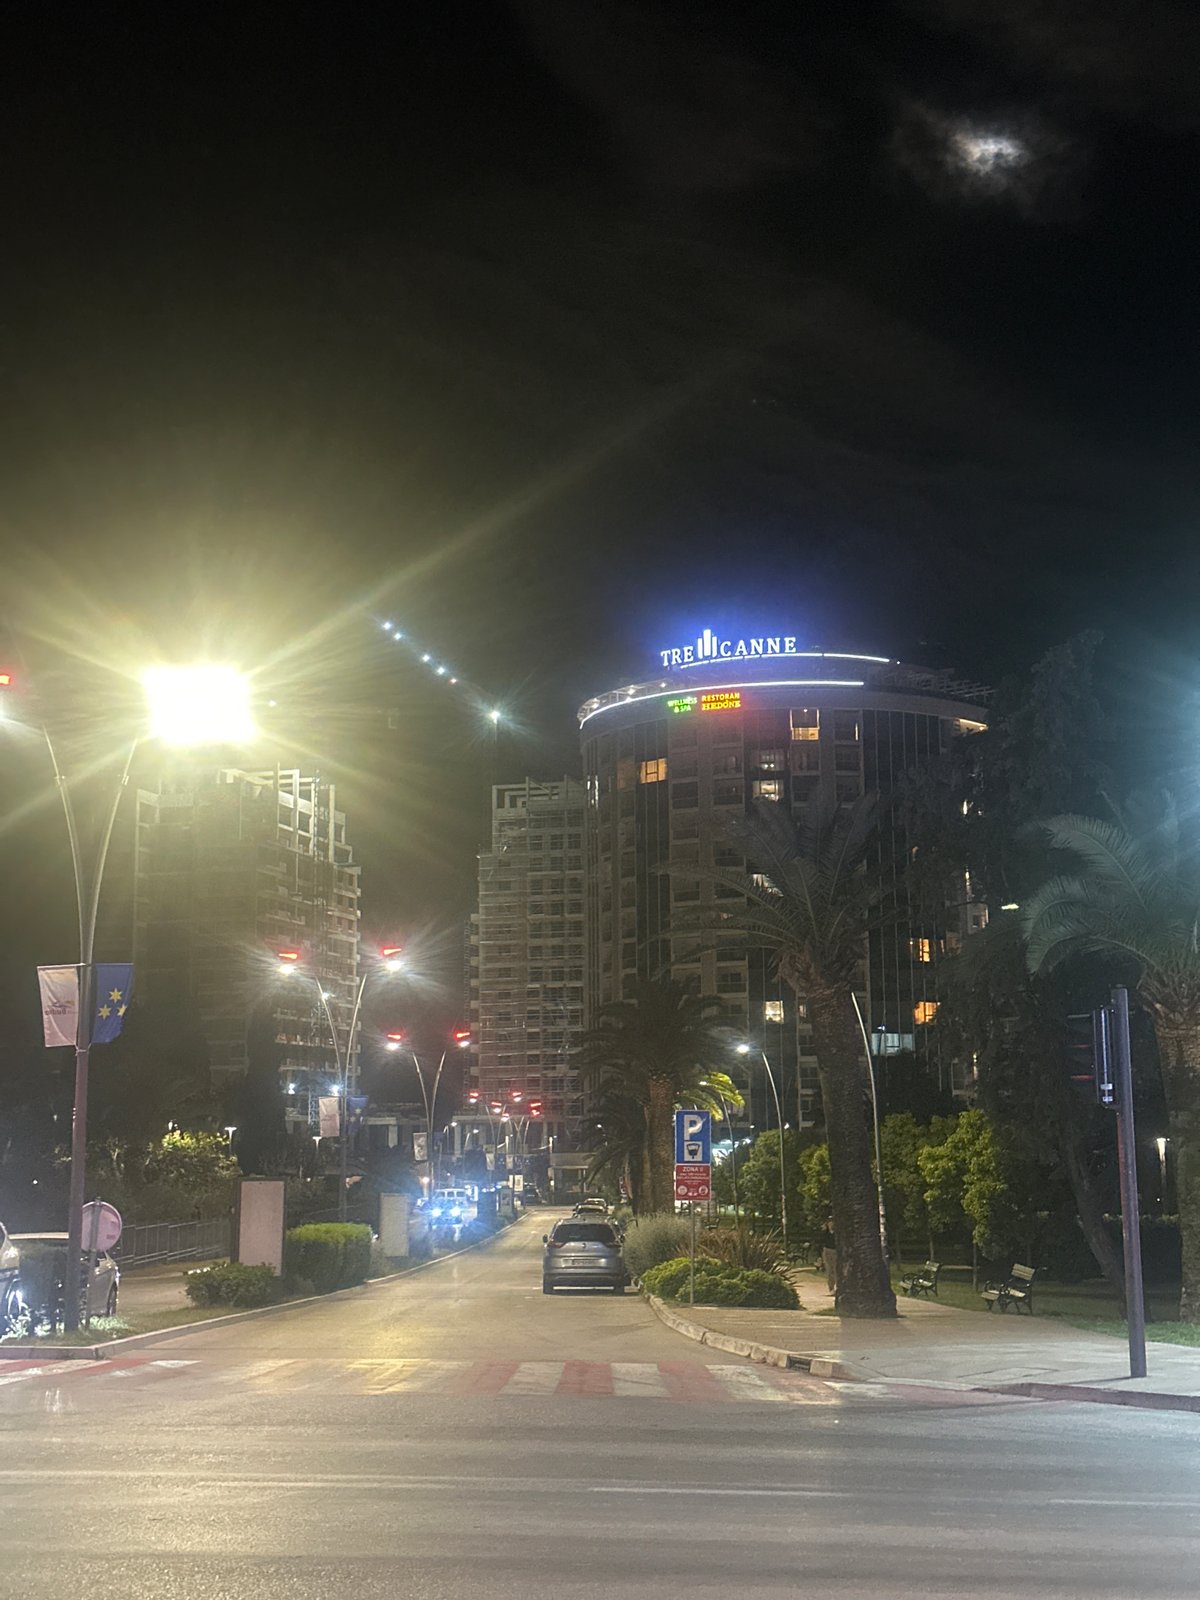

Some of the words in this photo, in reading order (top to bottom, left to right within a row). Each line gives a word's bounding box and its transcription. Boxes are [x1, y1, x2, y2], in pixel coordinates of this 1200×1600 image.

[660, 646, 694, 667] TRE
[720, 637, 797, 657] CANNE
[701, 692, 740, 702] RESTORAN
[680, 704, 692, 712] SPA
[684, 1114, 703, 1140] P
